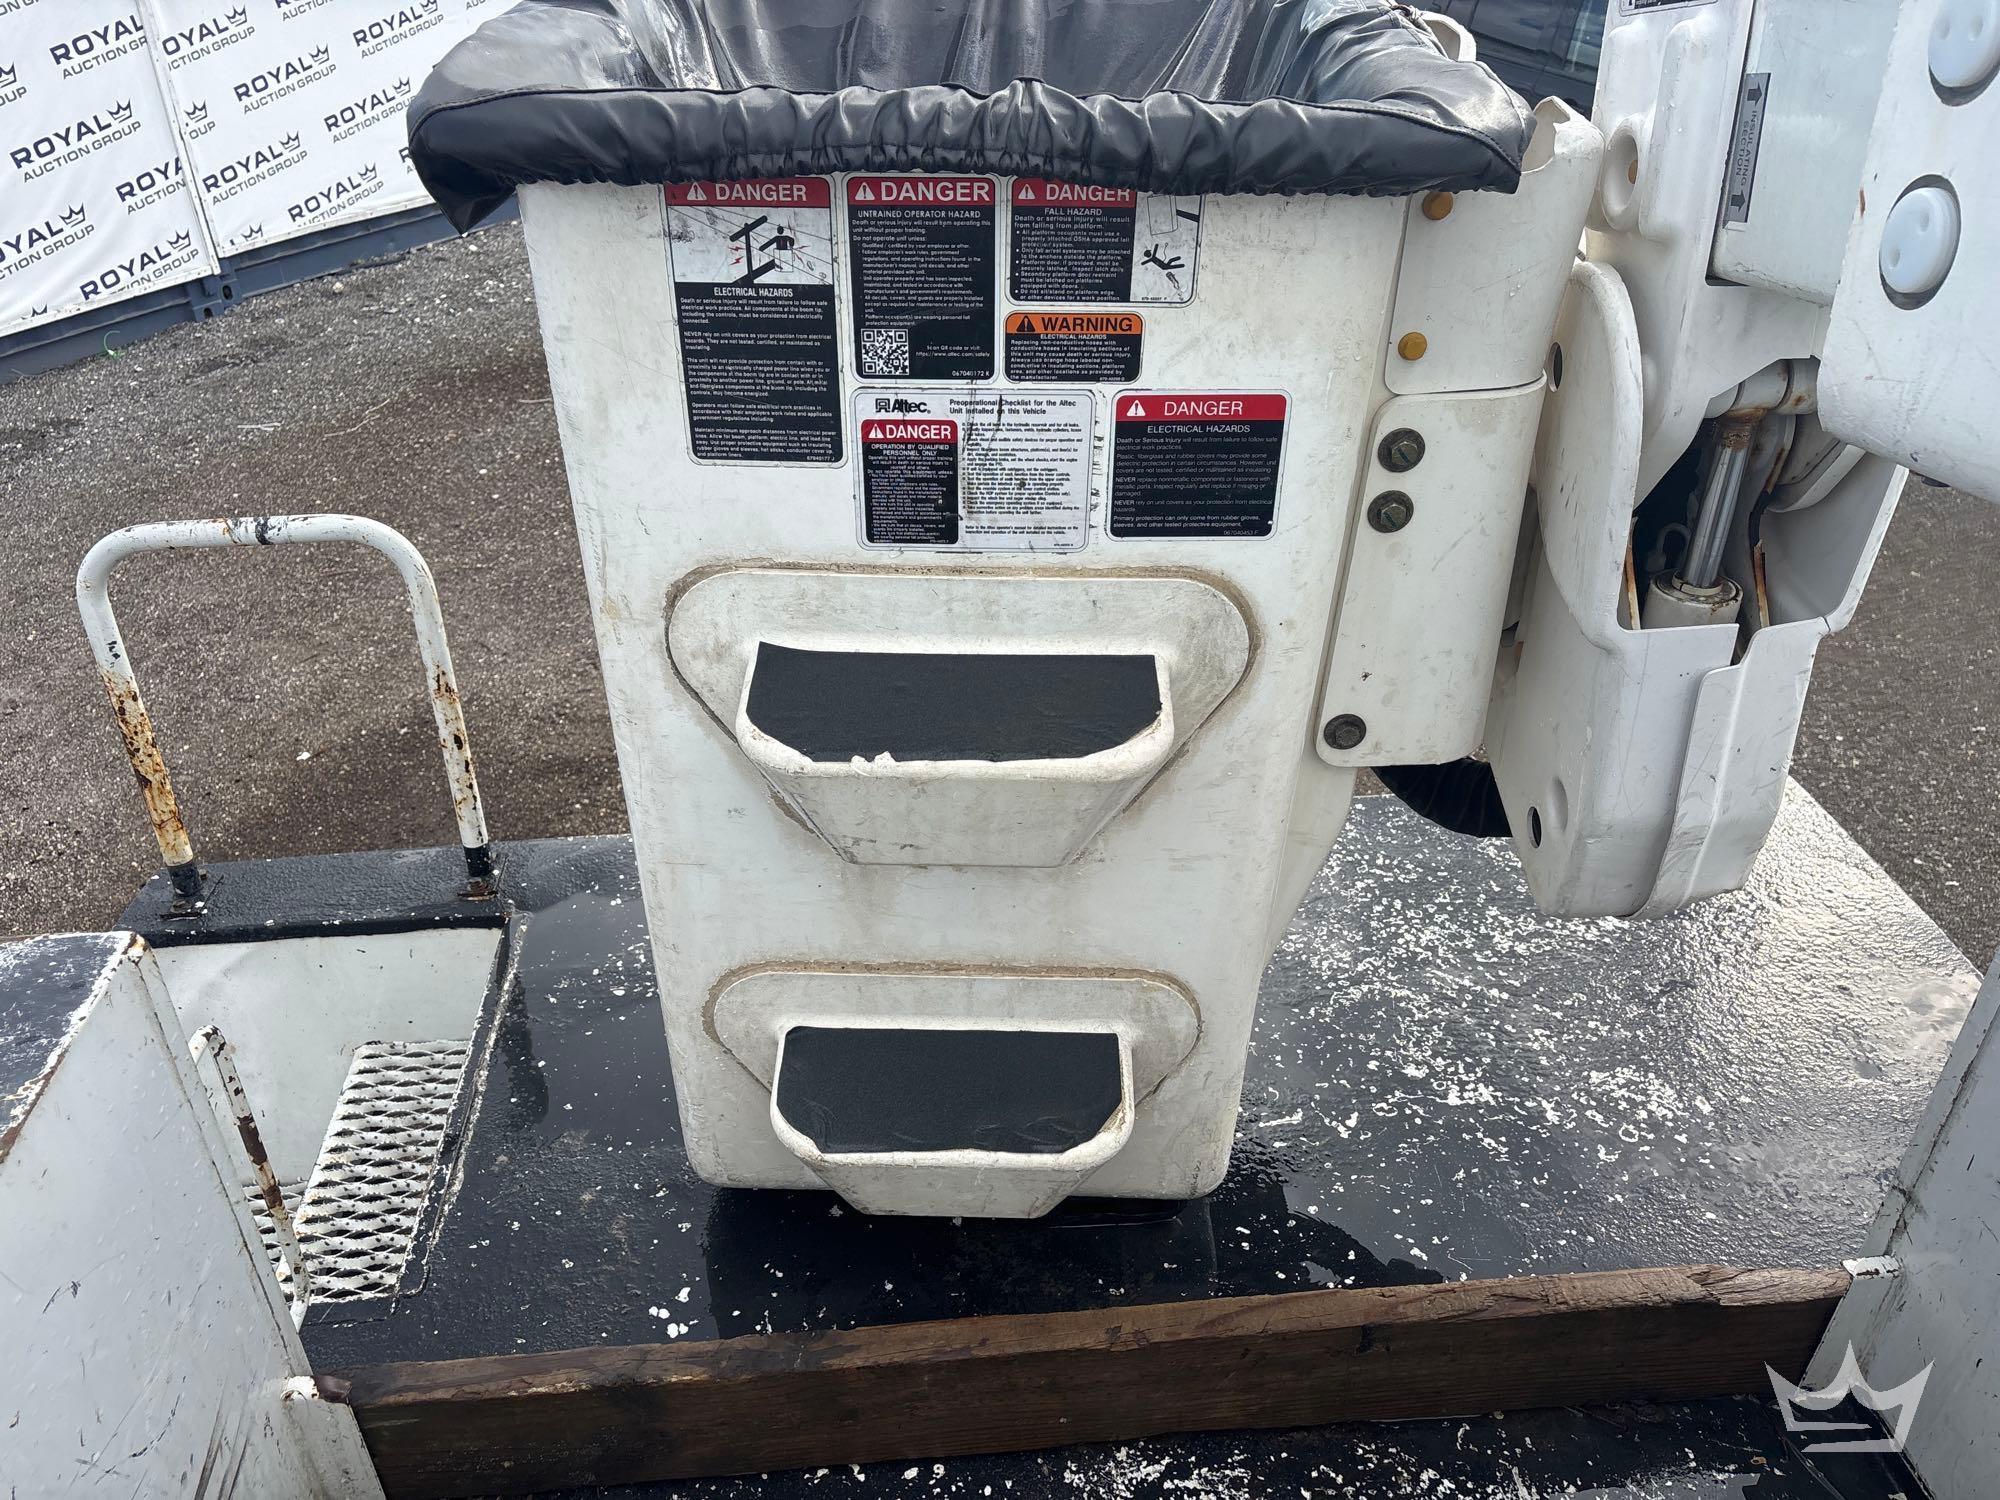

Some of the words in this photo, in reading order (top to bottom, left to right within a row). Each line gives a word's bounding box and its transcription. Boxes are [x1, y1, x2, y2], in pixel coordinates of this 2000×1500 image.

[49, 15, 143, 65] ROYAL
[161, 18, 230, 56] OYAL
[211, 26, 255, 52] GROUP
[353, 6, 423, 47] ROYAL
[361, 30, 408, 59] AUCTION
[409, 13, 444, 38] GROUP
[63, 44, 128, 80] AUCTION
[233, 57, 313, 102] ROYAL
[244, 82, 296, 114] AUCTION
[297, 63, 337, 89] GROUP
[324, 88, 396, 132] ROYAL
[333, 113, 380, 144] AUCTION
[9, 114, 112, 169] ROYAL
[24, 144, 91, 183] AUCTION
[92, 120, 142, 151] GROUP
[1736, 120, 1748, 176] SECTION
[1741, 110, 1757, 186] INSULATING
[202, 145, 283, 194] ROYAL
[212, 171, 266, 206] AUCTION
[267, 149, 308, 177] GROUP
[127, 178, 187, 215] AUCTION
[288, 176, 361, 223] ROYAL
[347, 180, 384, 207] GROUP
[715, 183, 807, 202] DANGER
[881, 182, 990, 201] DANGER
[1046, 183, 1130, 202] DANGER
[858, 210, 902, 218] UNTRAINED
[904, 210, 946, 218] OPERATOR
[949, 210, 981, 218] HAZARD
[0, 220, 64, 263] YAL
[43, 224, 95, 256] GROUP
[80, 245, 172, 301] ROYAL
[153, 248, 200, 279] GROUP
[714, 287, 757, 297] ELECTRICAL
[759, 288, 794, 297] HAZARDS
[1041, 317, 1133, 332] WARNING
[892, 398, 928, 413] Altec
[1164, 401, 1244, 416] DANGER
[886, 425, 951, 439] DANGER
[1148, 425, 1204, 433] ELECTRICAL
[1206, 425, 1251, 433] HAZARDS
